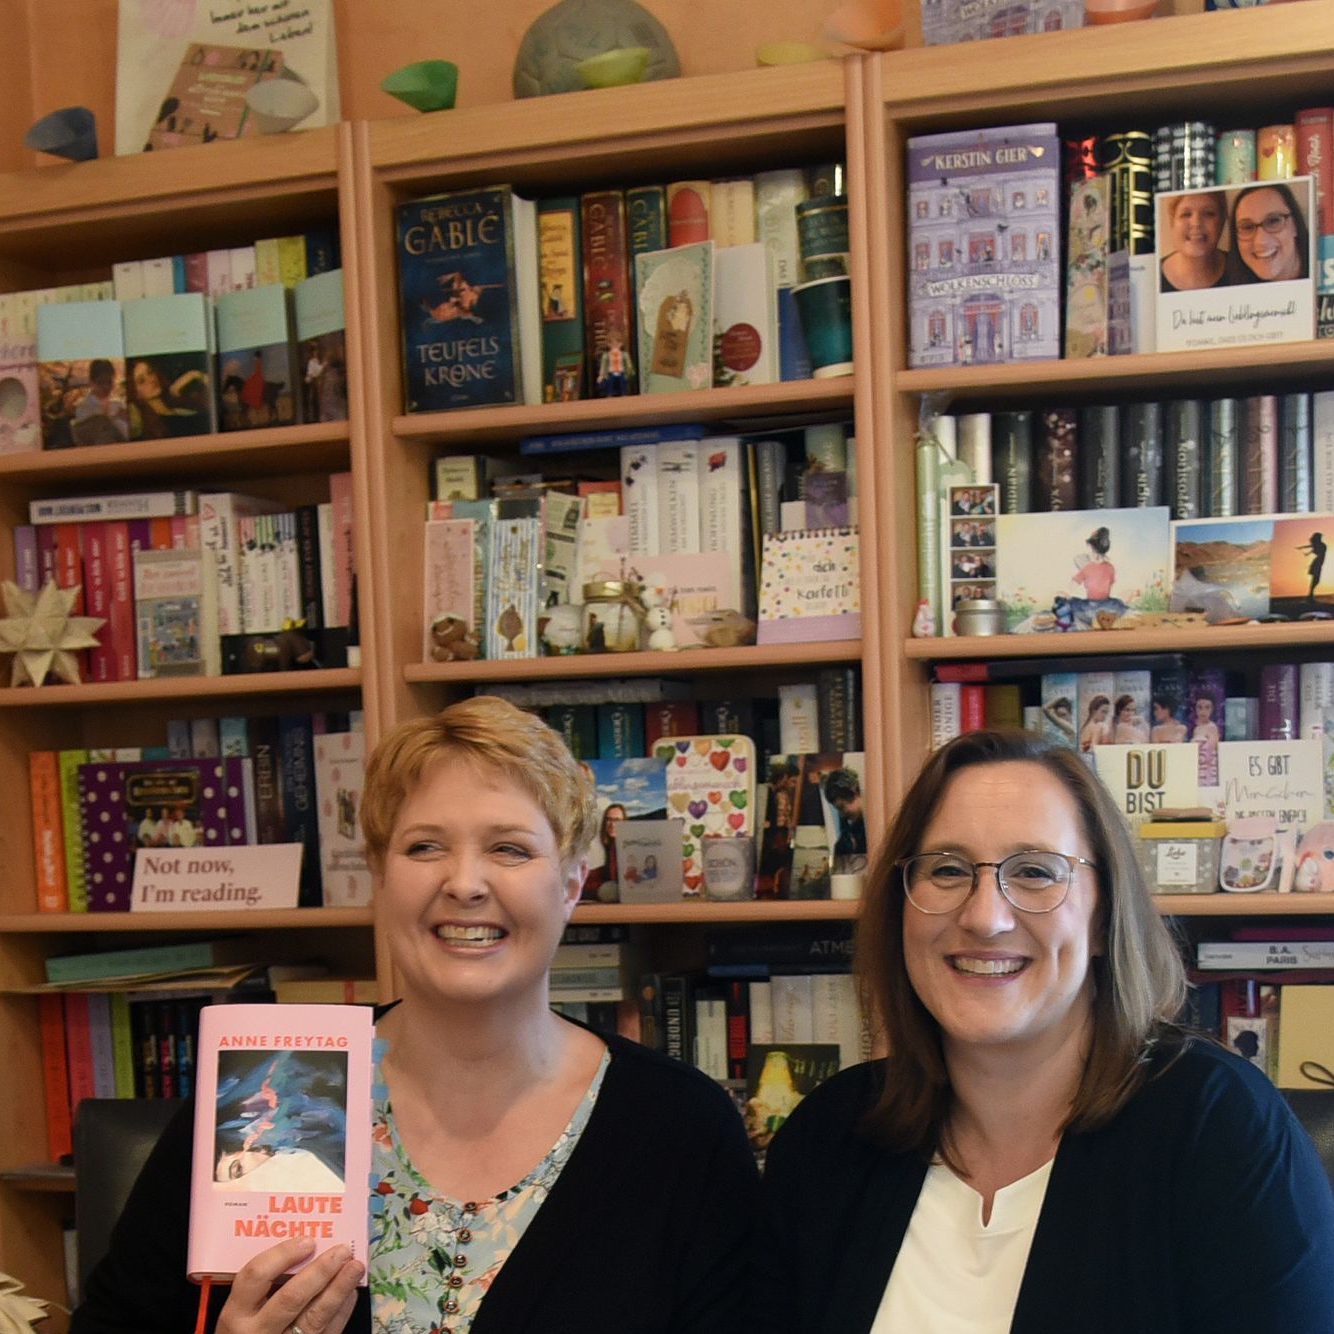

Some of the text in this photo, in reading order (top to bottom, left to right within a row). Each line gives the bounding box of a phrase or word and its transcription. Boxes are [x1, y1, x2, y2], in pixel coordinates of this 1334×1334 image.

[935, 147, 1028, 170] KERSTIN GIER
[930, 274, 1035, 295] WOLKENSCHLOSS
[1172, 309, 1187, 330] Du
[1188, 310, 1205, 326] bist
[1206, 314, 1226, 323] mein
[417, 336, 500, 364] TEUFELS
[424, 360, 497, 388] KRONE
[1127, 750, 1166, 790] DU
[1249, 755, 1291, 776] ES GIBT
[1126, 791, 1166, 814] BIST
[1225, 777, 1315, 805] Menschen
[144, 857, 235, 877] Not now,
[142, 882, 263, 905] I'm reading.
[1267, 956, 1298, 965] PARIS
[219, 1035, 349, 1049] ANNE FREYTAG
[269, 1196, 343, 1214] LAUTE
[234, 1215, 334, 1239] NÄCHTE
